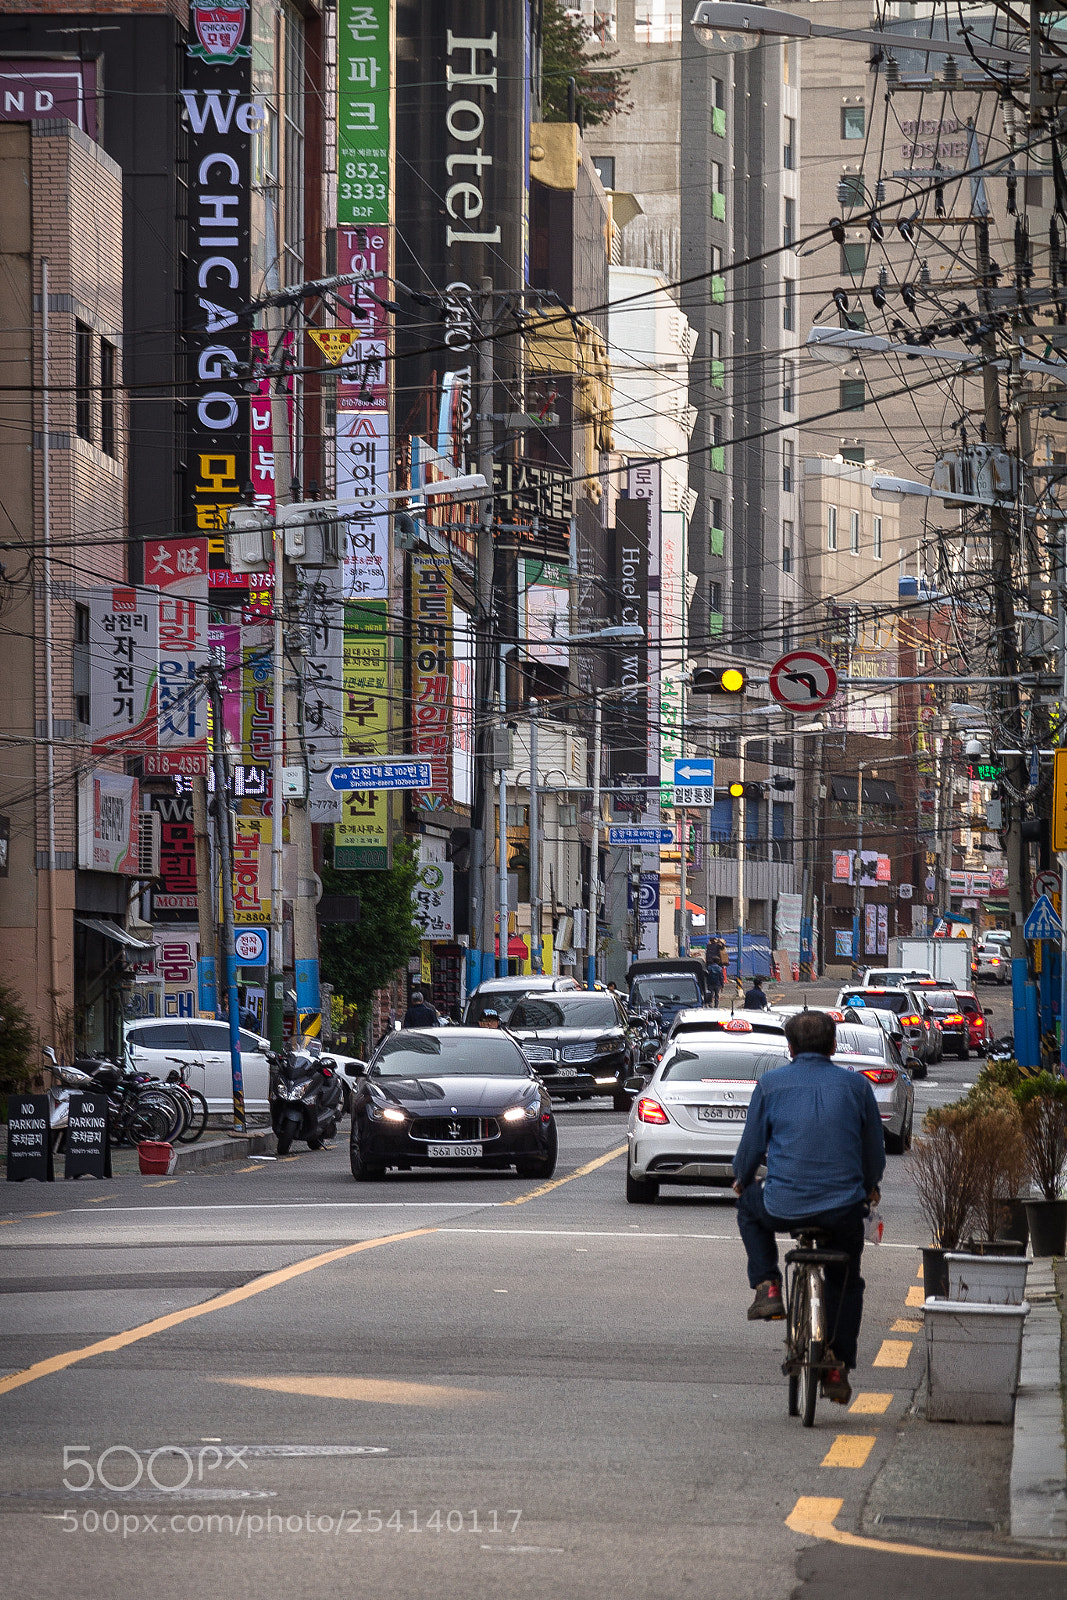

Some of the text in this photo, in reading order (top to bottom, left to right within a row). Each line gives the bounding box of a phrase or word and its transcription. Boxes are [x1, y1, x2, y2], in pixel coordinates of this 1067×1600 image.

[207, 33, 230, 48] 모텔
[180, 89, 266, 134] We
[901, 120, 958, 134] BUSAN
[445, 29, 502, 248] Hotel
[900, 142, 984, 158] BUSNESS
[345, 162, 387, 178] 852-
[340, 183, 386, 200] 3333
[352, 206, 374, 217] B2F
[198, 152, 240, 430] CHICAGO
[621, 547, 641, 600] Hotel
[355, 580, 370, 592] 3F
[101, 614, 148, 632] 삼천리
[159, 599, 202, 652] 대왕
[113, 636, 137, 724] 자전거
[148, 754, 206, 773] 818-4351
[676, 787, 712, 804] 일방통행
[20, 1104, 35, 1114] NO
[81, 1102, 95, 1114] NO
[9, 1118, 46, 1130] PARKING
[69, 1117, 106, 1128] PARKING
[12, 1133, 42, 1146] 주차금지
[71, 1131, 102, 1143] 주차금지
[454, 1146, 478, 1156] 0509
